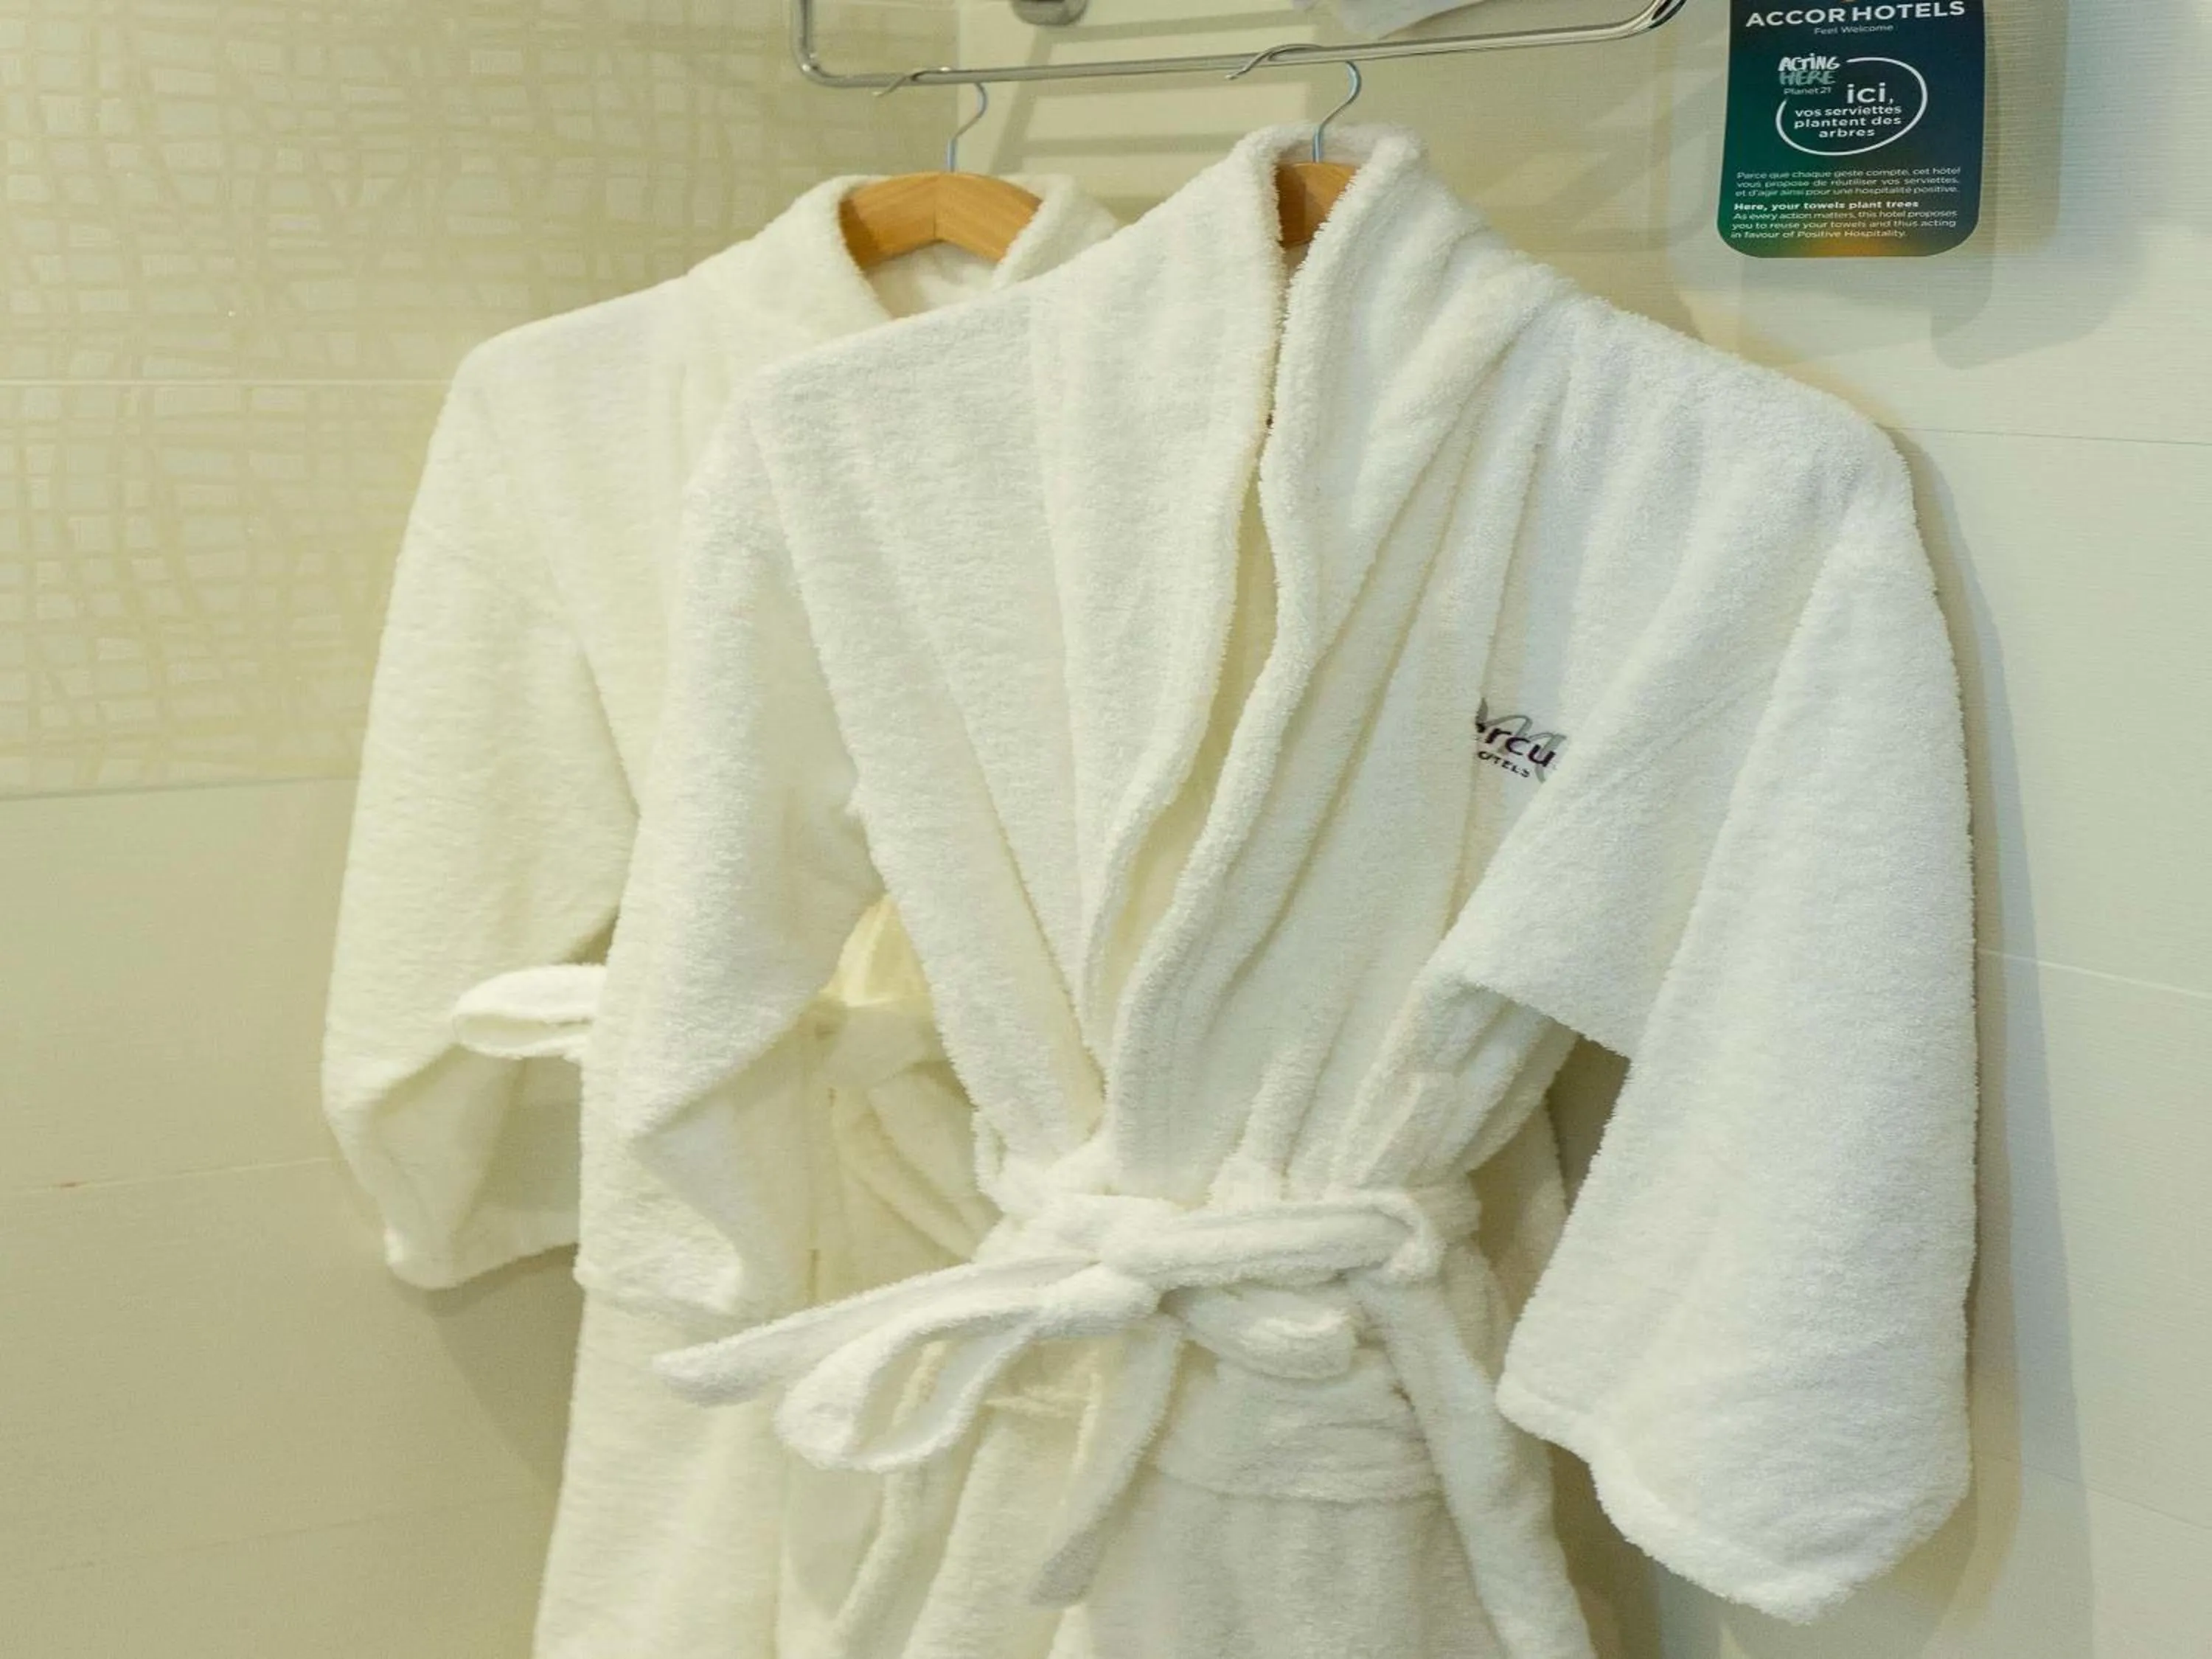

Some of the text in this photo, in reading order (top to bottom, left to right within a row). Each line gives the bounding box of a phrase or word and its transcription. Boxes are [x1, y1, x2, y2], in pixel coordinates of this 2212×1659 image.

[1814, 24, 1894, 35] Feel Welcome
[1846, 82, 1893, 105] ici,
[1795, 105, 1902, 117] vos serviettes
[1794, 116, 1902, 129] plantent des
[1818, 128, 1876, 139] arbres
[1792, 170, 1832, 179] chaque
[1764, 180, 1809, 188] propose
[1806, 189, 1831, 197] pour
[1733, 203, 1768, 211] Here,
[1771, 203, 1801, 212] your
[1804, 201, 1845, 209] towels
[1848, 201, 1882, 209] plant
[1779, 212, 1812, 220] action
[1858, 210, 1878, 218] this
[1880, 210, 1906, 218] hotel
[1907, 210, 1958, 218] proposes
[1802, 222, 1828, 230] your
[1831, 220, 1866, 229] towels
[1869, 220, 1891, 228] and
[1893, 219, 1917, 227] thus
[1919, 219, 1956, 228] acting
[1744, 230, 1781, 238] favour
[1782, 230, 1794, 238] of
[1797, 230, 1841, 238] Positive
